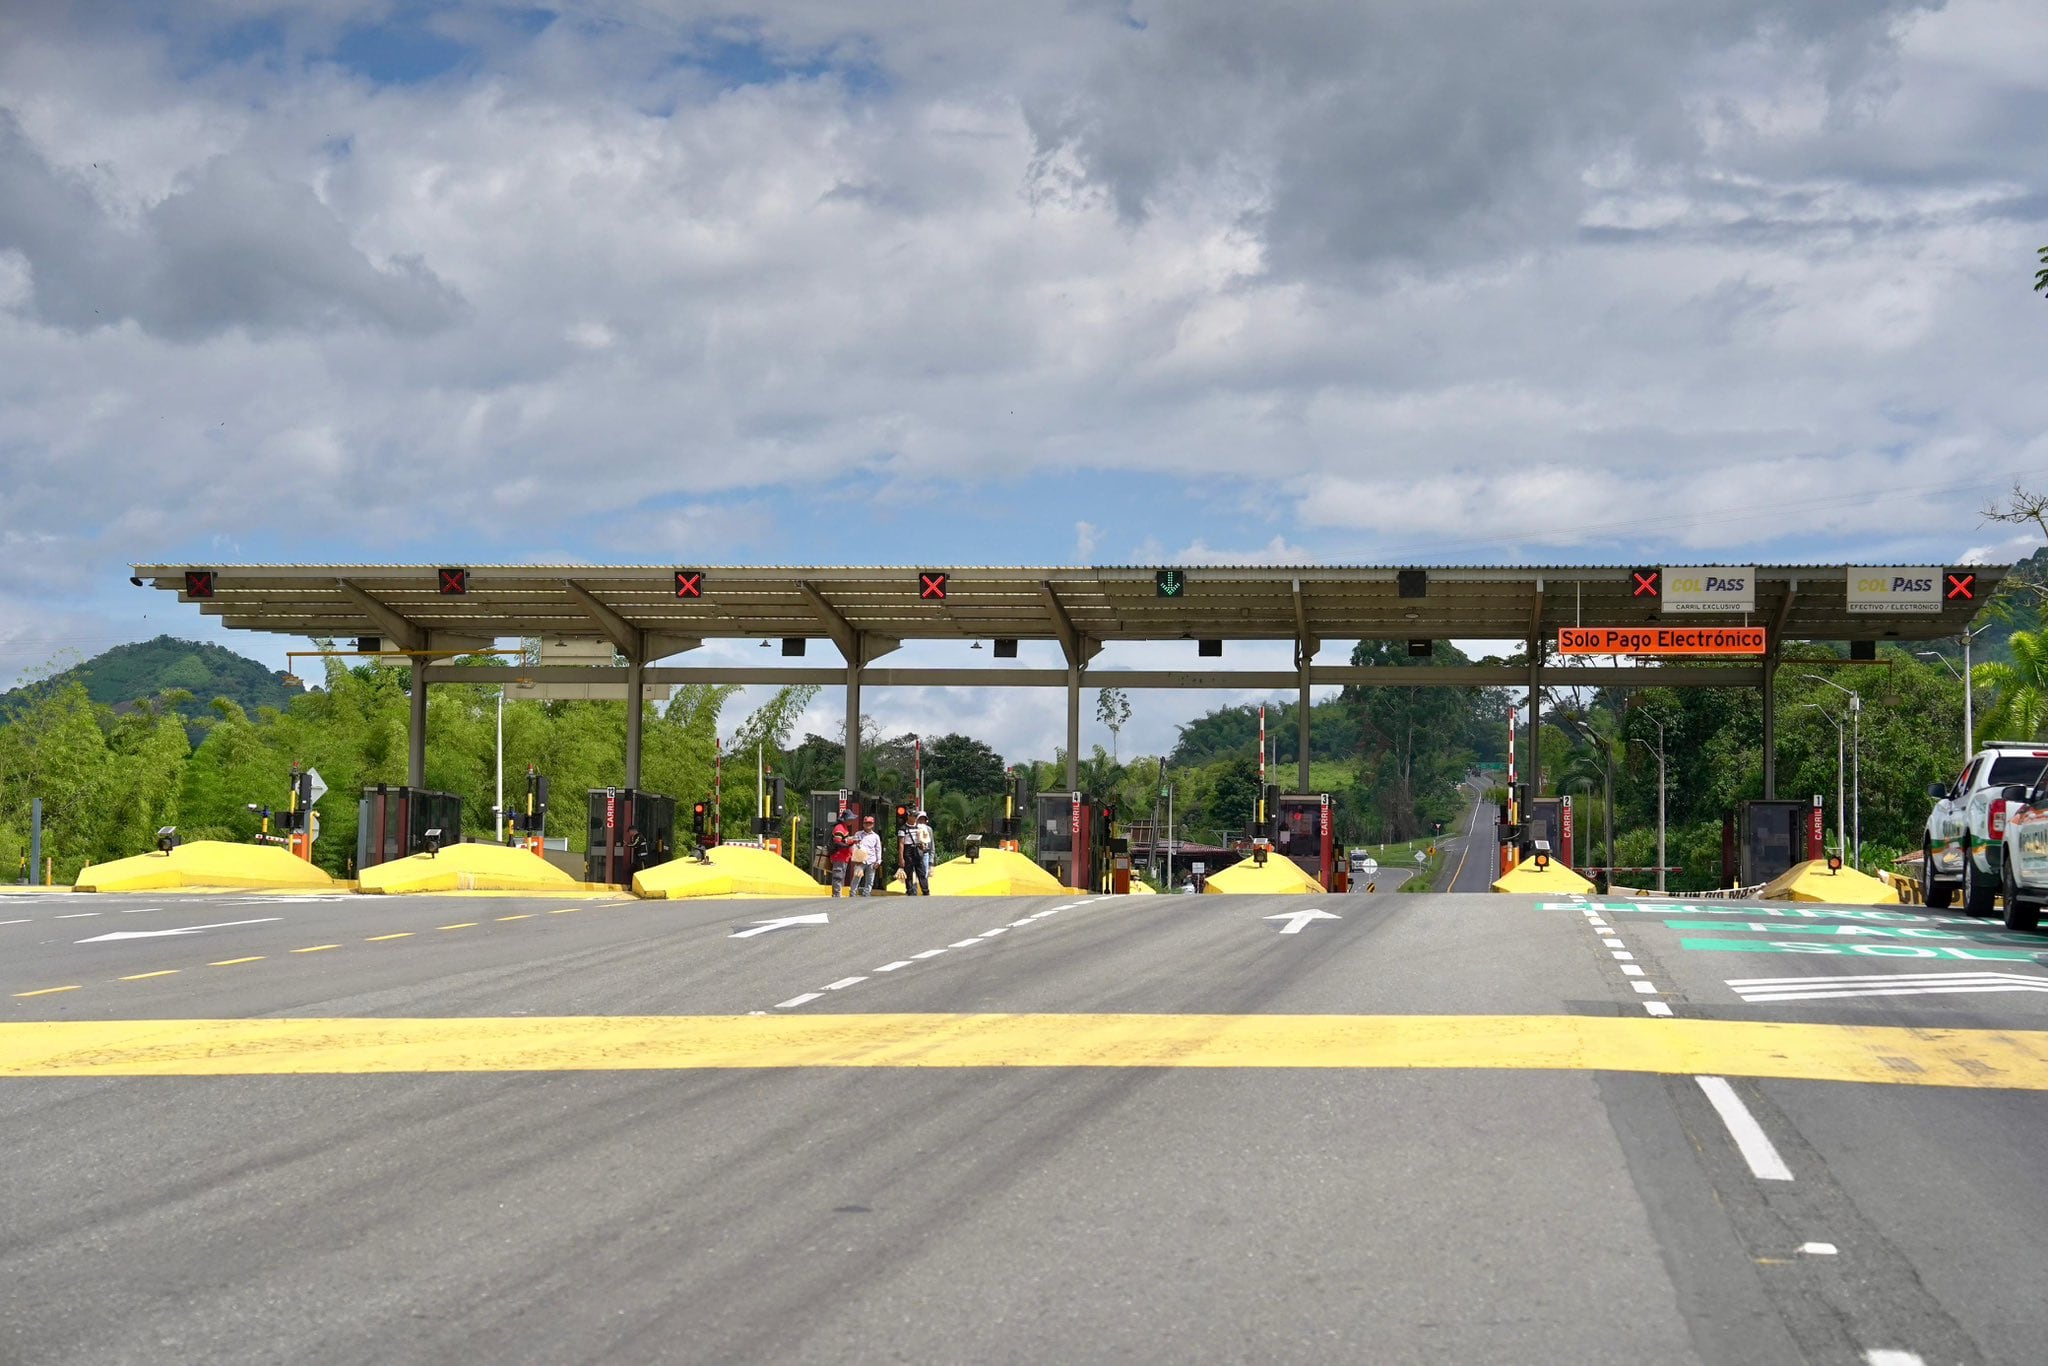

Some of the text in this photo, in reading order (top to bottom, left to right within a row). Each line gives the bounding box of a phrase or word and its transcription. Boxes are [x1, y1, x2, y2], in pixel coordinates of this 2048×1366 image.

[1675, 603, 1741, 611] CARRIL EXCLUSIVO
[1561, 630, 1763, 652] Solo Pago Electrónico
[840, 789, 847, 800] 11
[606, 798, 615, 828] CARRIL
[1072, 792, 1080, 833] CARRIL 4
[1320, 794, 1329, 836] CARRIL 3
[1563, 796, 1572, 838] CARRIL 2
[1814, 807, 1823, 841] CARRIL
[1768, 941, 2048, 963] SOL
